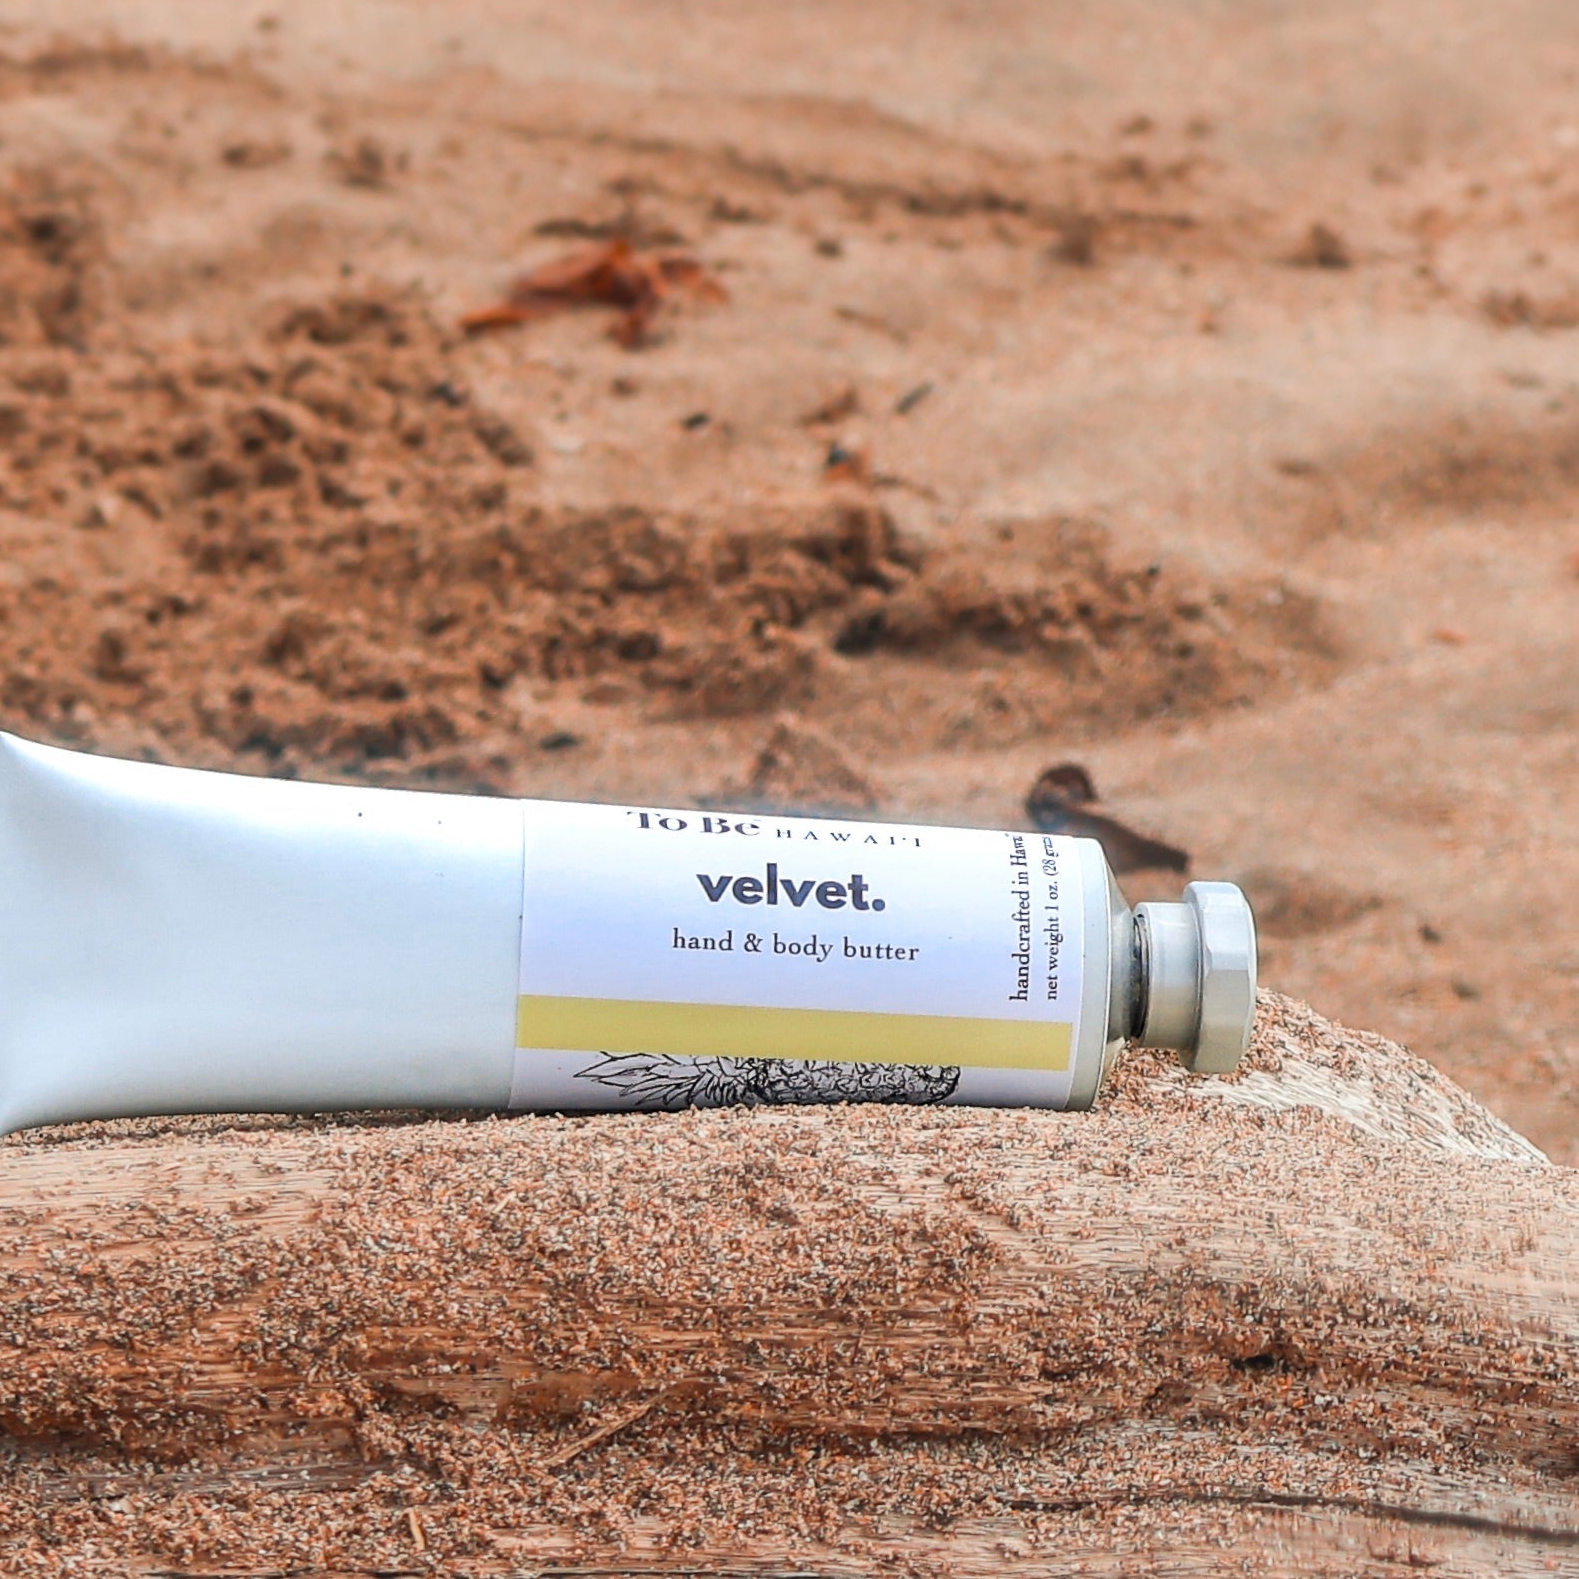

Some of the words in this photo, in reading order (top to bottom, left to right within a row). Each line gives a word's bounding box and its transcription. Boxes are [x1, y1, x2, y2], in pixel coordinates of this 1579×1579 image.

[627, 811, 688, 831] To
[700, 816, 760, 836] Be
[1011, 871, 1029, 885] in
[1042, 858, 1059, 876] (28
[696, 862, 886, 912] velvet.
[1048, 881, 1059, 900] oz.
[672, 927, 733, 951] hand
[744, 933, 763, 952] &
[773, 933, 833, 962] body
[844, 936, 919, 961] butter
[1009, 890, 1030, 1002] handcrafted
[1043, 916, 1064, 971] weight
[1046, 974, 1058, 1000] net
